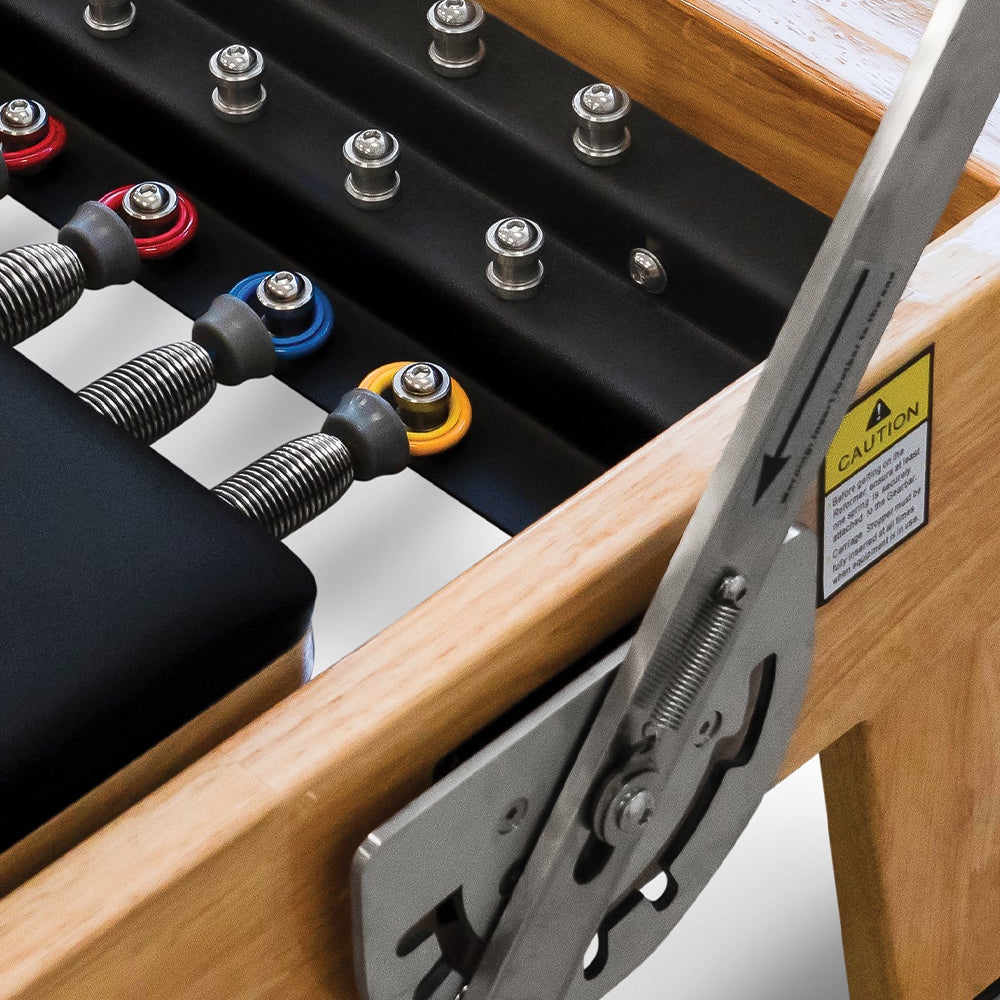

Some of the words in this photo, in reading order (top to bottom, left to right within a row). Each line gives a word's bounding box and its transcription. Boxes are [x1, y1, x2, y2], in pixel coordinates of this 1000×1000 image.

[838, 402, 919, 472] CAUTION
[832, 485, 855, 507] Before
[857, 465, 881, 490] getting
[882, 457, 891, 469] on
[833, 516, 845, 530] one
[847, 499, 869, 520] spring
[872, 491, 878, 500] is
[882, 468, 910, 493] securely
[869, 468, 894, 491] ensure
[894, 461, 902, 472] at
[903, 447, 920, 465] least
[832, 532, 863, 559] Carriage
[866, 508, 893, 533] Stopper
[895, 493, 911, 511] must
[913, 487, 921, 498] be
[832, 557, 847, 573] fully
[848, 532, 877, 560] inserted
[878, 527, 885, 538] at
[886, 520, 894, 532] all
[895, 506, 914, 524] times
[833, 513, 863, 543] attached
[832, 566, 850, 584] when
[852, 536, 888, 569] equipment
[890, 532, 896, 541] is
[896, 526, 904, 536] in
